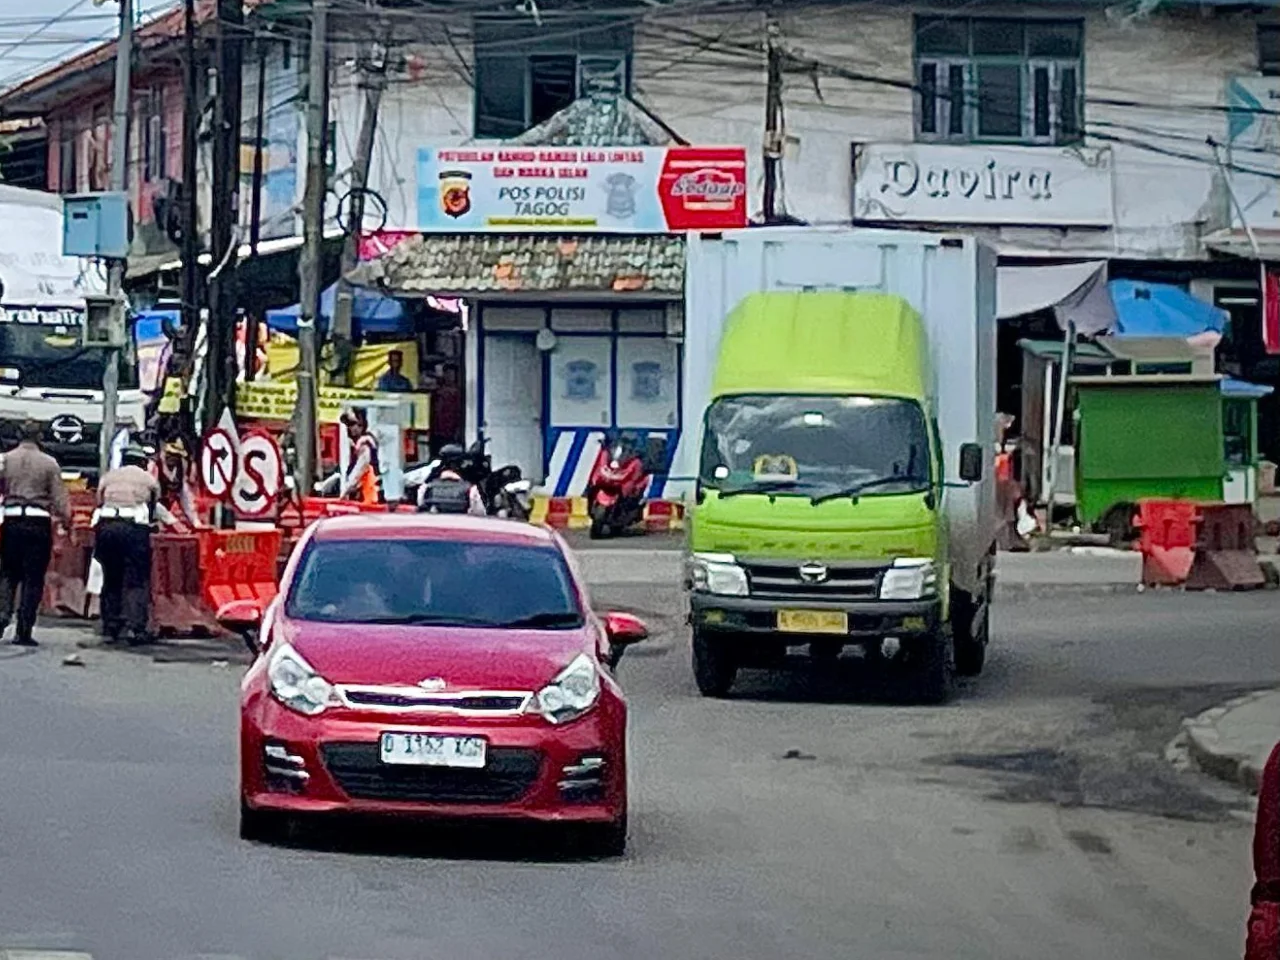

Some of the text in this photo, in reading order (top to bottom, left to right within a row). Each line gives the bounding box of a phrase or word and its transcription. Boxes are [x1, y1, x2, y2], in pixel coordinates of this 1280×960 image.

[879, 156, 1053, 200] Davira
[498, 186, 585, 201] POS POLISI
[514, 201, 570, 216] TAGOG
